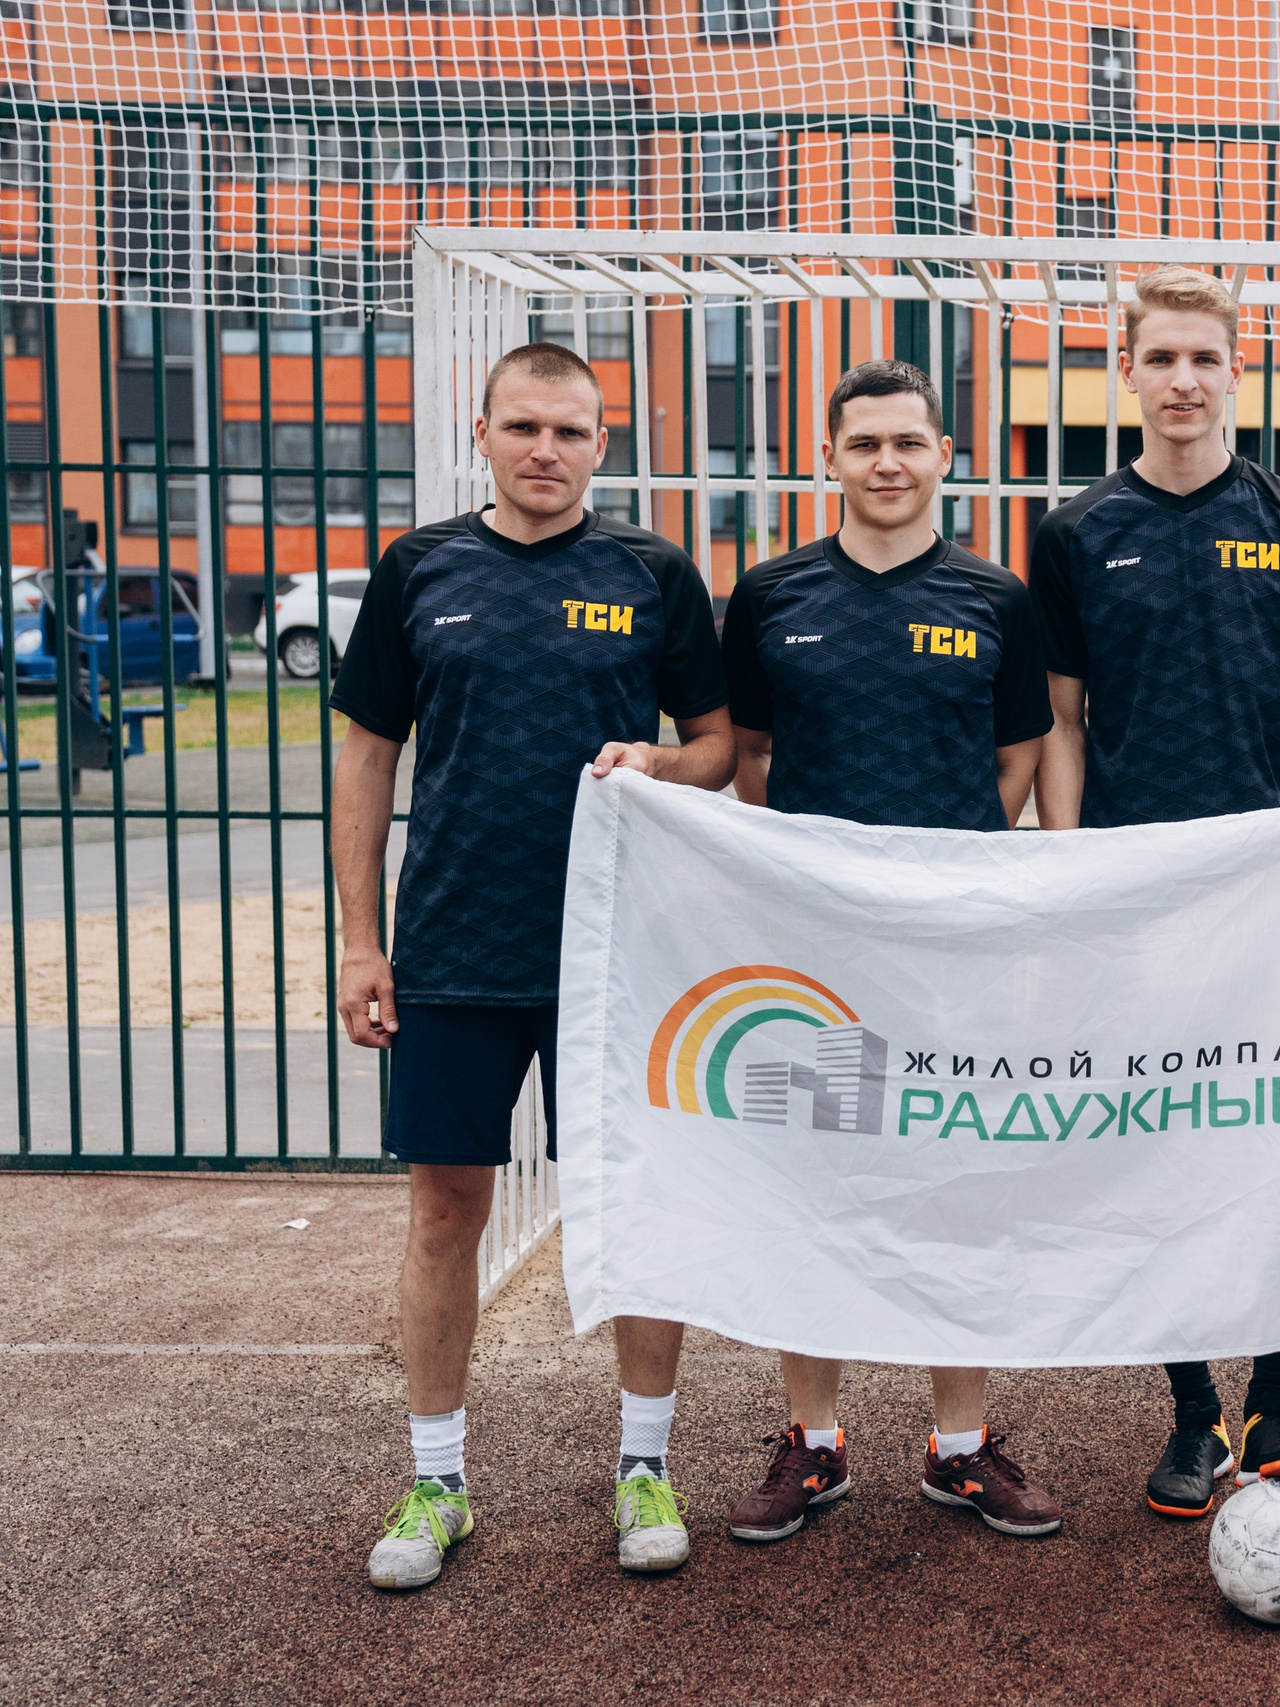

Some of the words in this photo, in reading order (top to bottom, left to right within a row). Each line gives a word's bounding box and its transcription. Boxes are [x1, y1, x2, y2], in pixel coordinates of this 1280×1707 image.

[1117, 556, 1142, 567] SPORT
[1215, 540, 1280, 571] ТСИ
[446, 614, 472, 624] SPORT
[562, 599, 634, 635] ТСИ
[797, 634, 823, 643] SPORT
[908, 623, 977, 659] ТСИ
